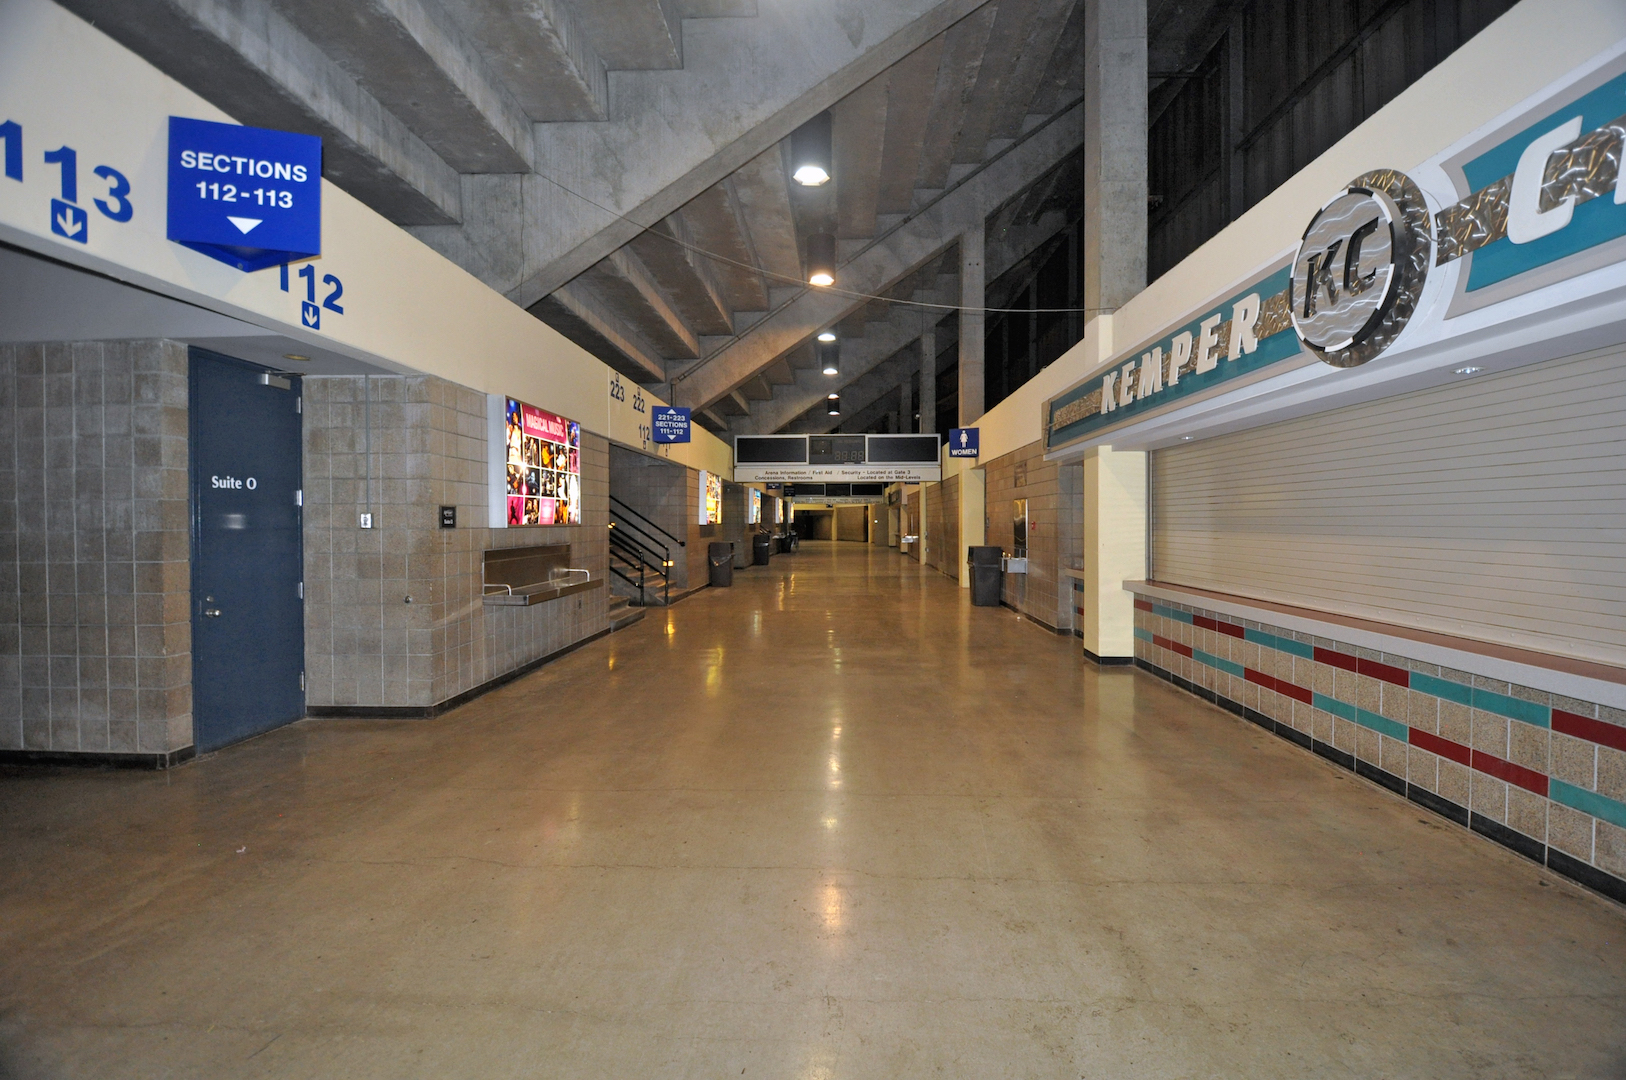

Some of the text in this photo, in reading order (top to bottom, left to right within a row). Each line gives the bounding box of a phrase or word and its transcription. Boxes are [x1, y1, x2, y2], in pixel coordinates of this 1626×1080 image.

[0, 119, 133, 223] 113
[180, 150, 308, 183] SECTIONS
[196, 181, 293, 209] 112-113
[1303, 216, 1380, 319] KC
[279, 263, 344, 315] 112
[1100, 292, 1260, 415] KEMPER
[610, 380, 625, 403] 223
[633, 394, 645, 414] 222
[525, 412, 564, 438] MAGICAL MUSIC
[639, 423, 650, 441] 112
[951, 448, 978, 456] WOMEN
[211, 475, 242, 489] Suite
